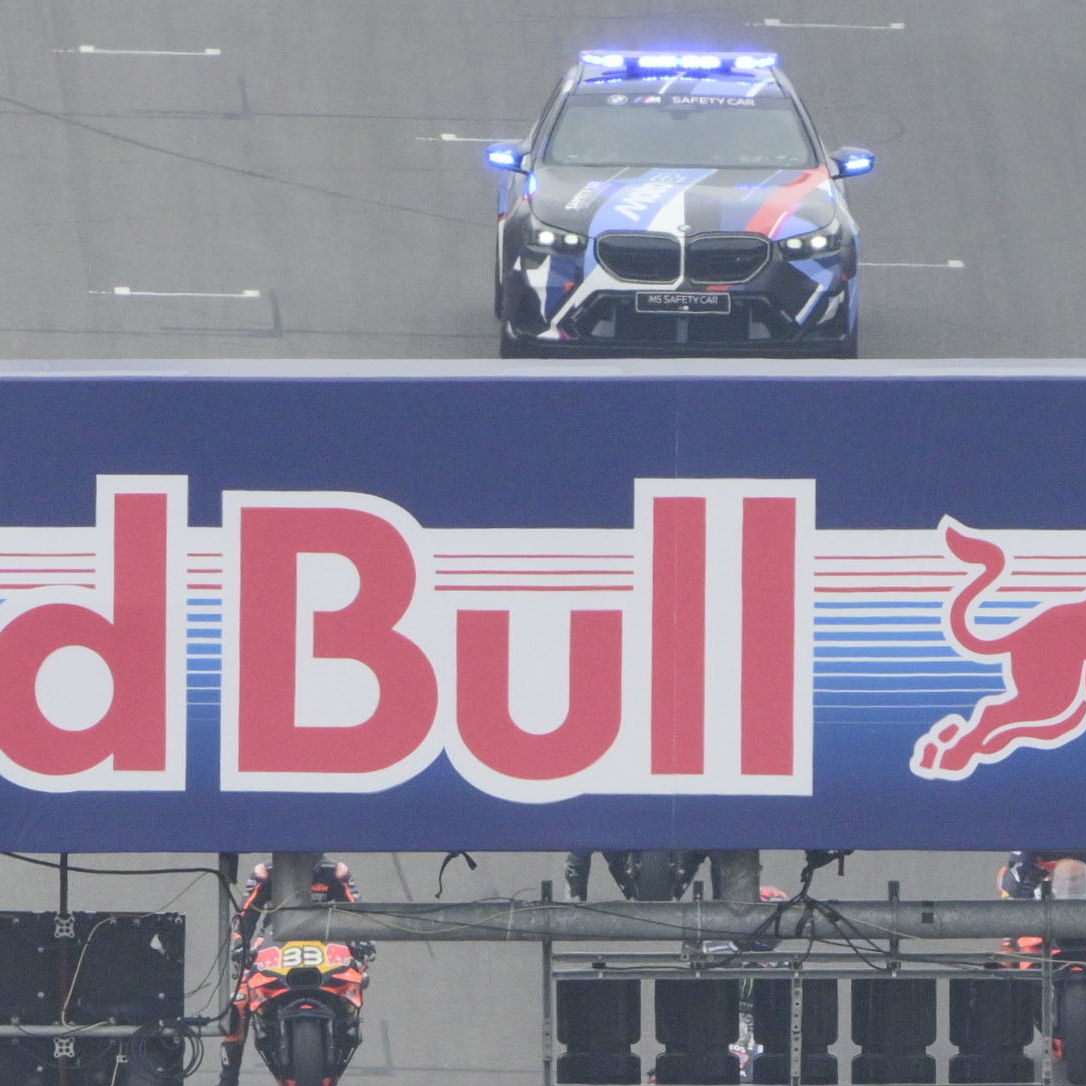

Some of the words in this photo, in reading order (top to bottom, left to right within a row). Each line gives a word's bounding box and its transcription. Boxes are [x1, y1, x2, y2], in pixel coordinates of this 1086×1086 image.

[672, 96, 725, 105] SAFETY
[727, 97, 755, 106] CAR
[663, 295, 698, 304] SAFETY
[700, 296, 719, 305] CAR
[230, 487, 805, 790] Bull
[281, 946, 323, 968] 33
